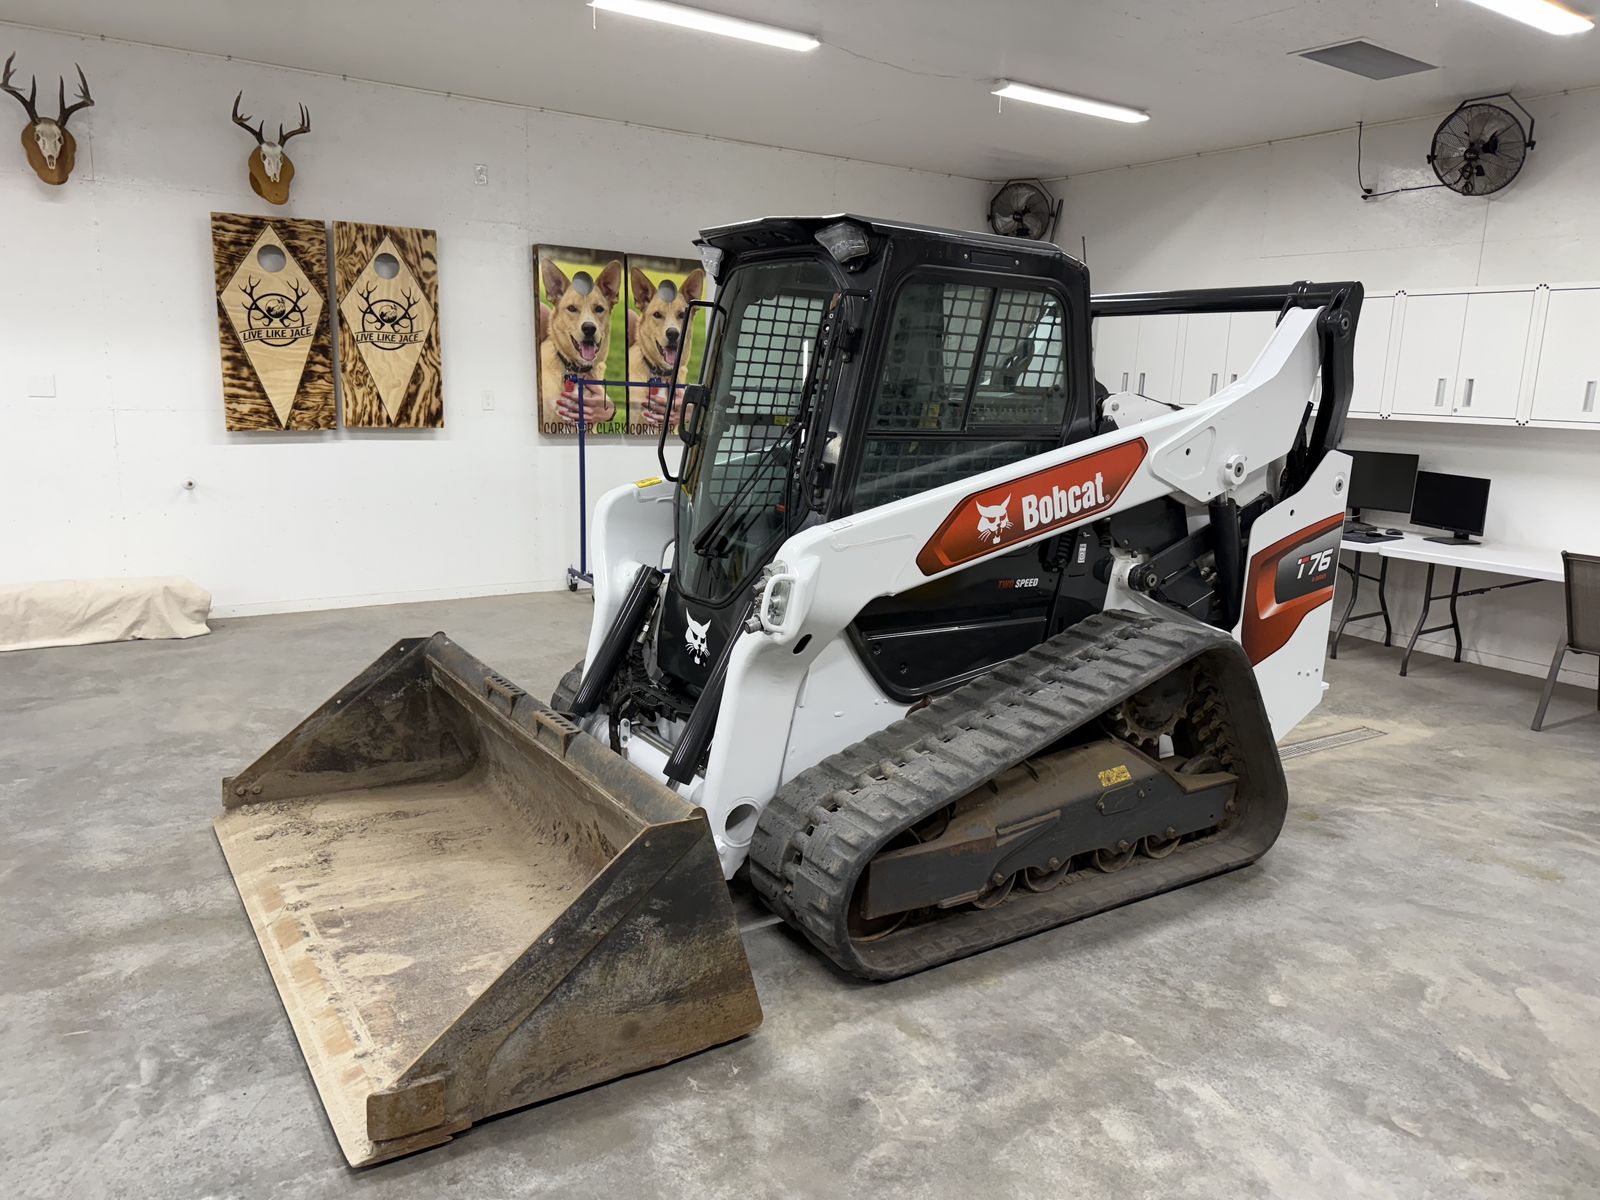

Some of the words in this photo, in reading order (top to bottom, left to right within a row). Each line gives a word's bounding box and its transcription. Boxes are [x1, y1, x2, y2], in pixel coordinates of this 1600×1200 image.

[243, 330, 263, 341] LIVE
[266, 329, 287, 338] LIKE
[290, 326, 311, 338] JACE
[355, 332, 374, 342] LIVE
[377, 333, 396, 342] LIKE
[399, 333, 419, 343] JACE
[543, 422, 572, 435] CORN
[575, 422, 594, 434] FR
[596, 422, 628, 434] CLARK
[629, 423, 655, 436] CORN
[658, 423, 675, 435] FR
[1021, 471, 1105, 531] Bobcat
[1296, 548, 1334, 580] T76
[1015, 577, 1039, 588] SPEED
